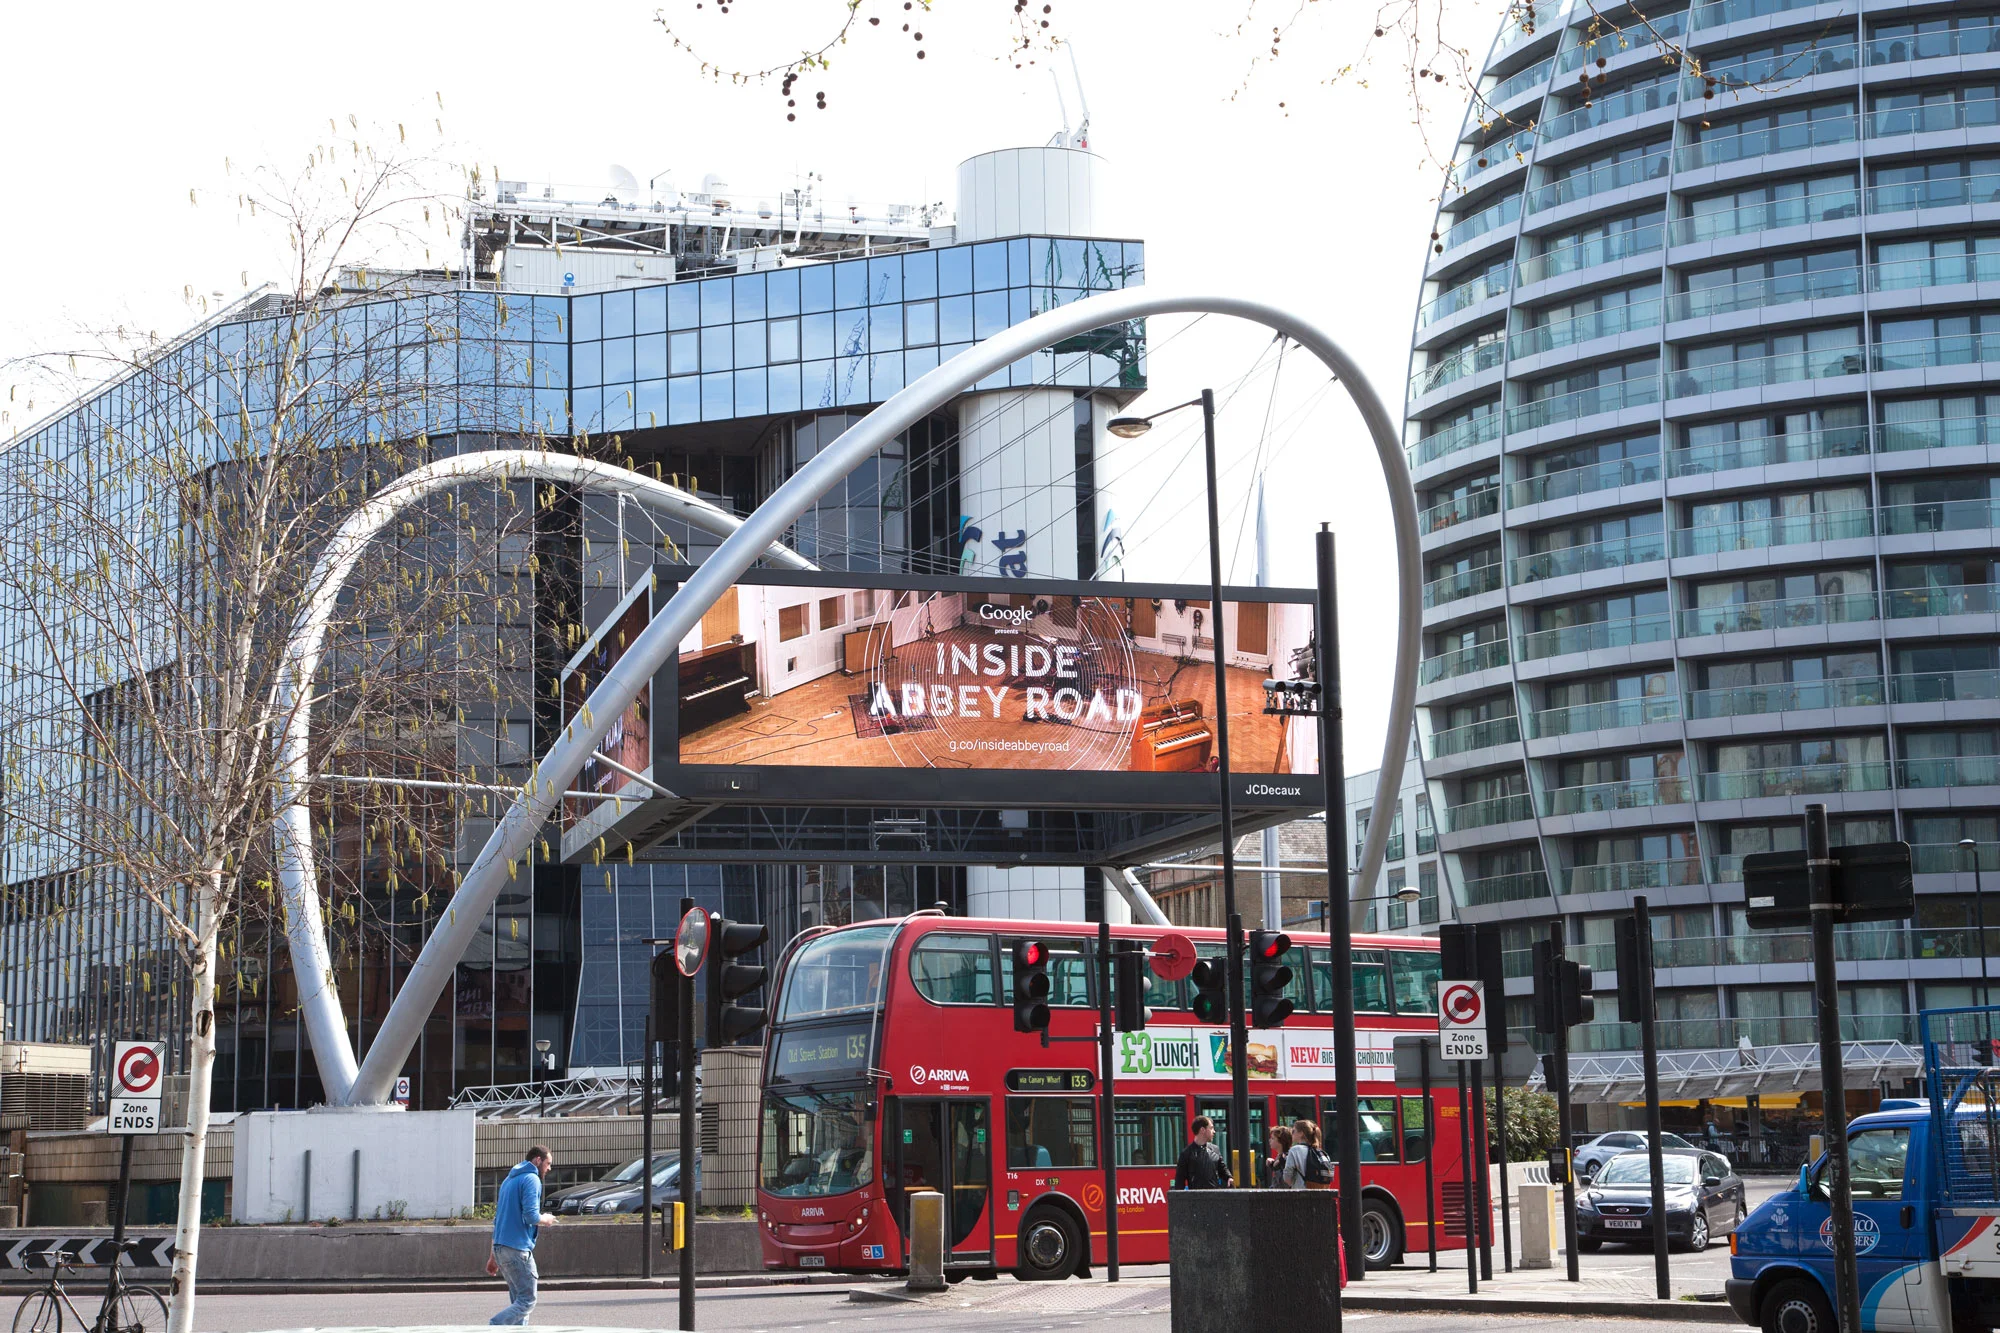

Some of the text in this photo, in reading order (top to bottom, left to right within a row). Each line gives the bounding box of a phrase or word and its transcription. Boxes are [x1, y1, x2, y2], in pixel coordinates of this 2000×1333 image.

[991, 529, 1027, 578] at
[980, 604, 1033, 625] Google
[936, 642, 1078, 678] INSIDE
[868, 682, 1143, 722] ABBEY ROAD
[949, 739, 1069, 753] g.co/insideabbeyroad
[1245, 783, 1301, 796] JCDecaux
[1451, 1033, 1475, 1042] Zone
[788, 1034, 867, 1063] Old Street Station 135
[1121, 1031, 1199, 1073] £3 LUNCH
[1446, 1044, 1483, 1055] ENDS
[1290, 1047, 1320, 1063] NEW
[1321, 1051, 1333, 1064] BIG
[1357, 1051, 1385, 1064] CHORIZO
[928, 1069, 970, 1081] ARRIVA
[1028, 1075, 1045, 1085] Canary
[1047, 1075, 1061, 1084] Wharf
[1071, 1076, 1087, 1087] 135
[122, 1103, 148, 1113] Zone
[114, 1116, 154, 1129] ENDS
[1007, 1172, 1018, 1180] T16
[801, 1208, 825, 1217] ARRIVA
[1126, 1205, 1145, 1213] London
[1826, 1219, 1874, 1232] PICO
[1826, 1236, 1875, 1246] PBERS
